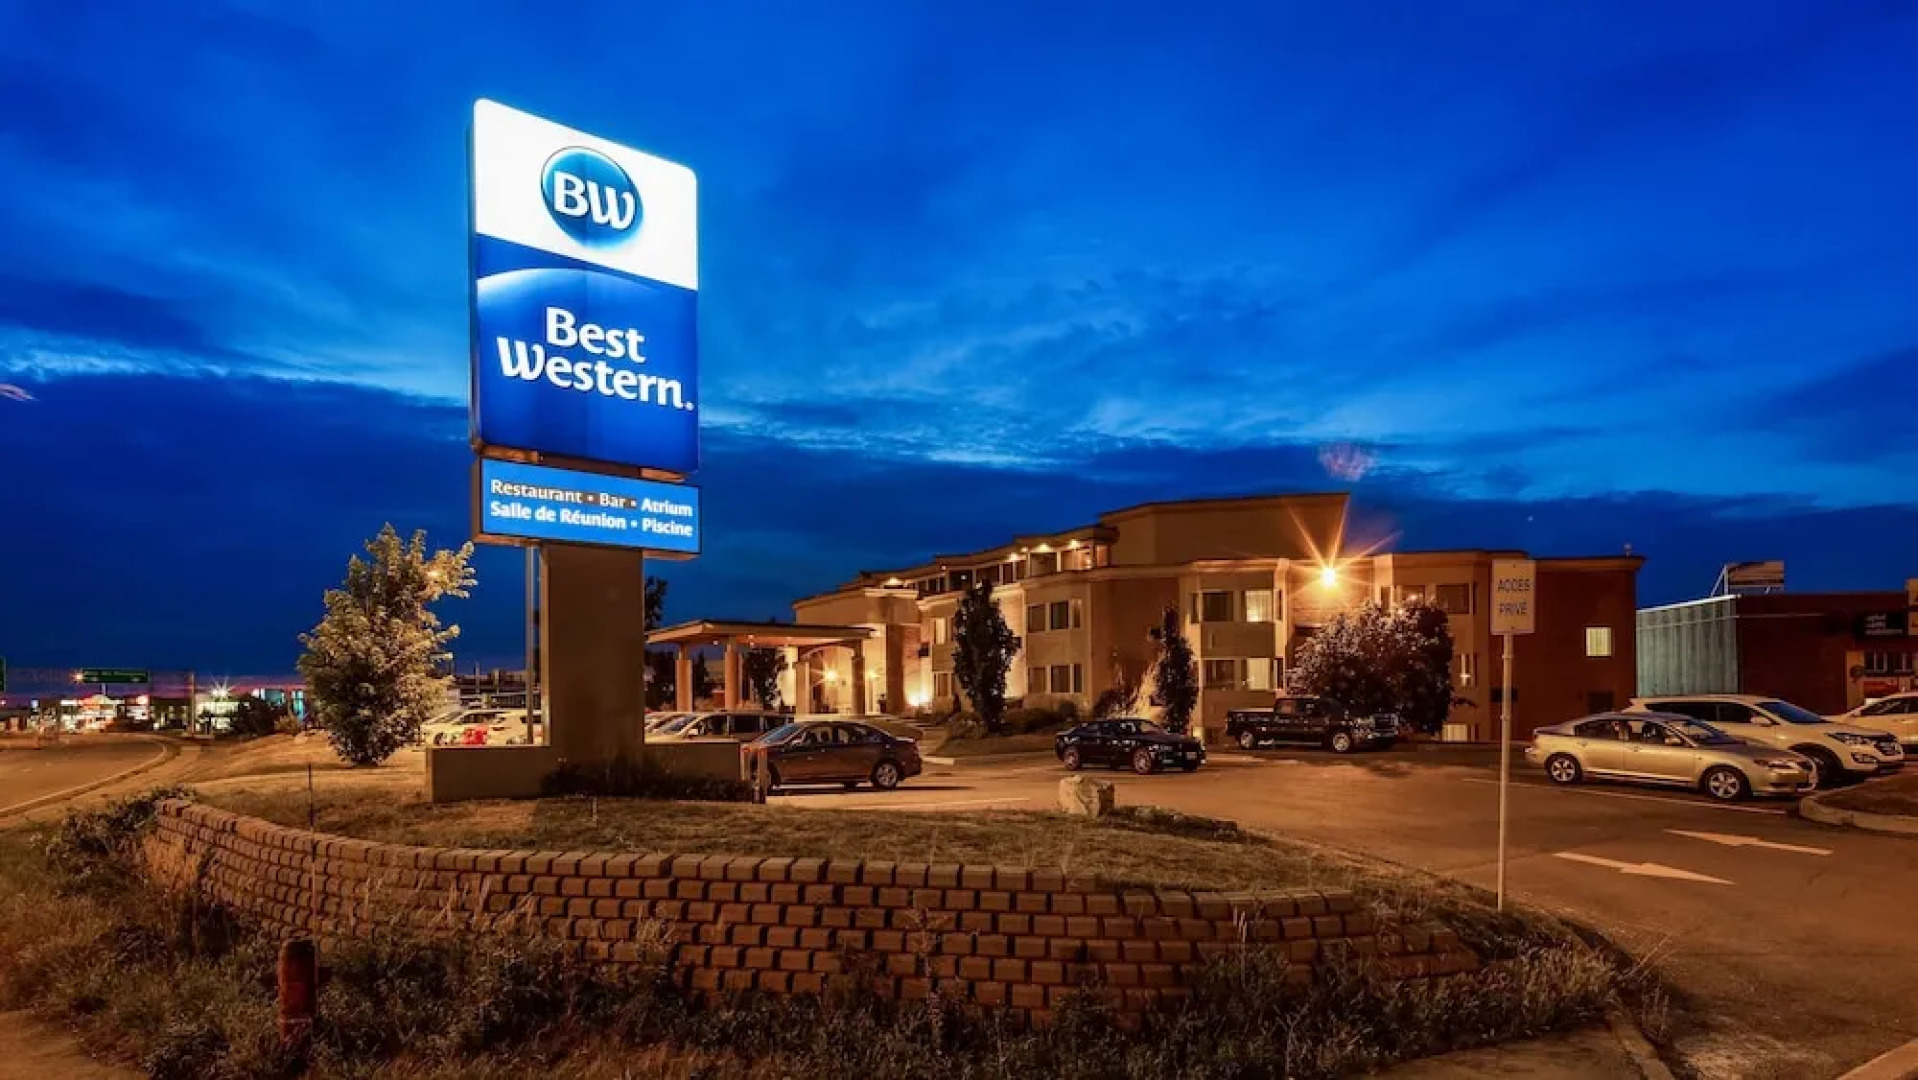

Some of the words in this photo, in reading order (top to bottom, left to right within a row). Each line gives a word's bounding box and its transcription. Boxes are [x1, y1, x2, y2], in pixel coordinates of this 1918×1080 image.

[553, 170, 636, 230] BW
[546, 306, 646, 364] Best
[490, 479, 583, 504] Restaurant
[600, 492, 627, 509] Bar
[641, 498, 693, 517] Atrium
[490, 501, 532, 520] Salle
[535, 505, 557, 523] de
[559, 507, 627, 530] Réunion
[642, 517, 693, 537] Piscine
